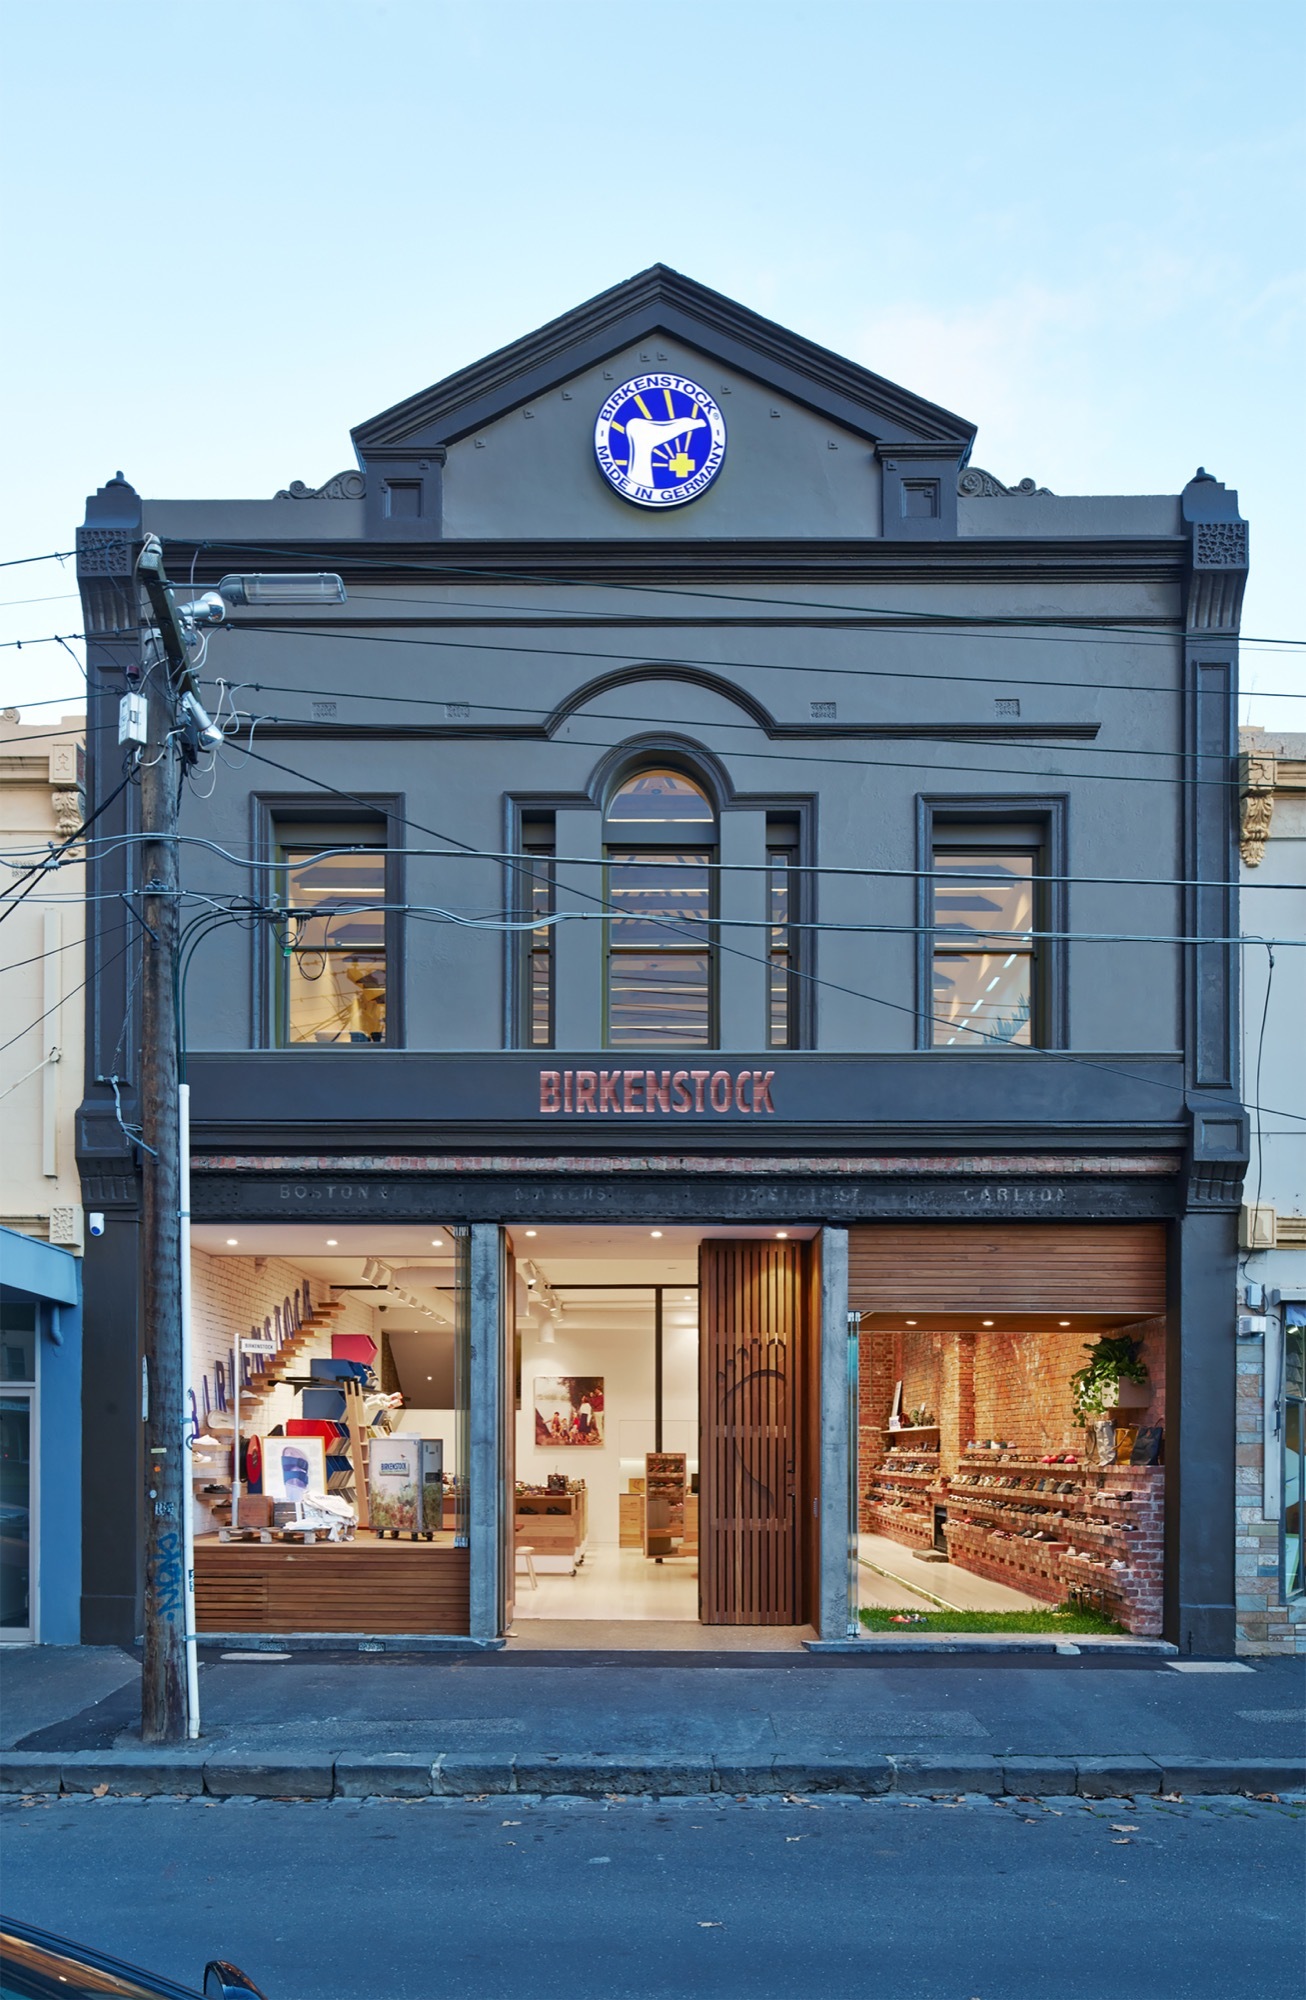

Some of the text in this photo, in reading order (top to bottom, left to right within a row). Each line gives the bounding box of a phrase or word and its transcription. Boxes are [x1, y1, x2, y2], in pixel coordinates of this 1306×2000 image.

[600, 376, 716, 422] BIRKENSTOCK
[597, 440, 723, 500] MADE IN GERMANY
[539, 1070, 775, 1113] BIRKENSTOCK
[280, 1184, 369, 1200] BOSTON
